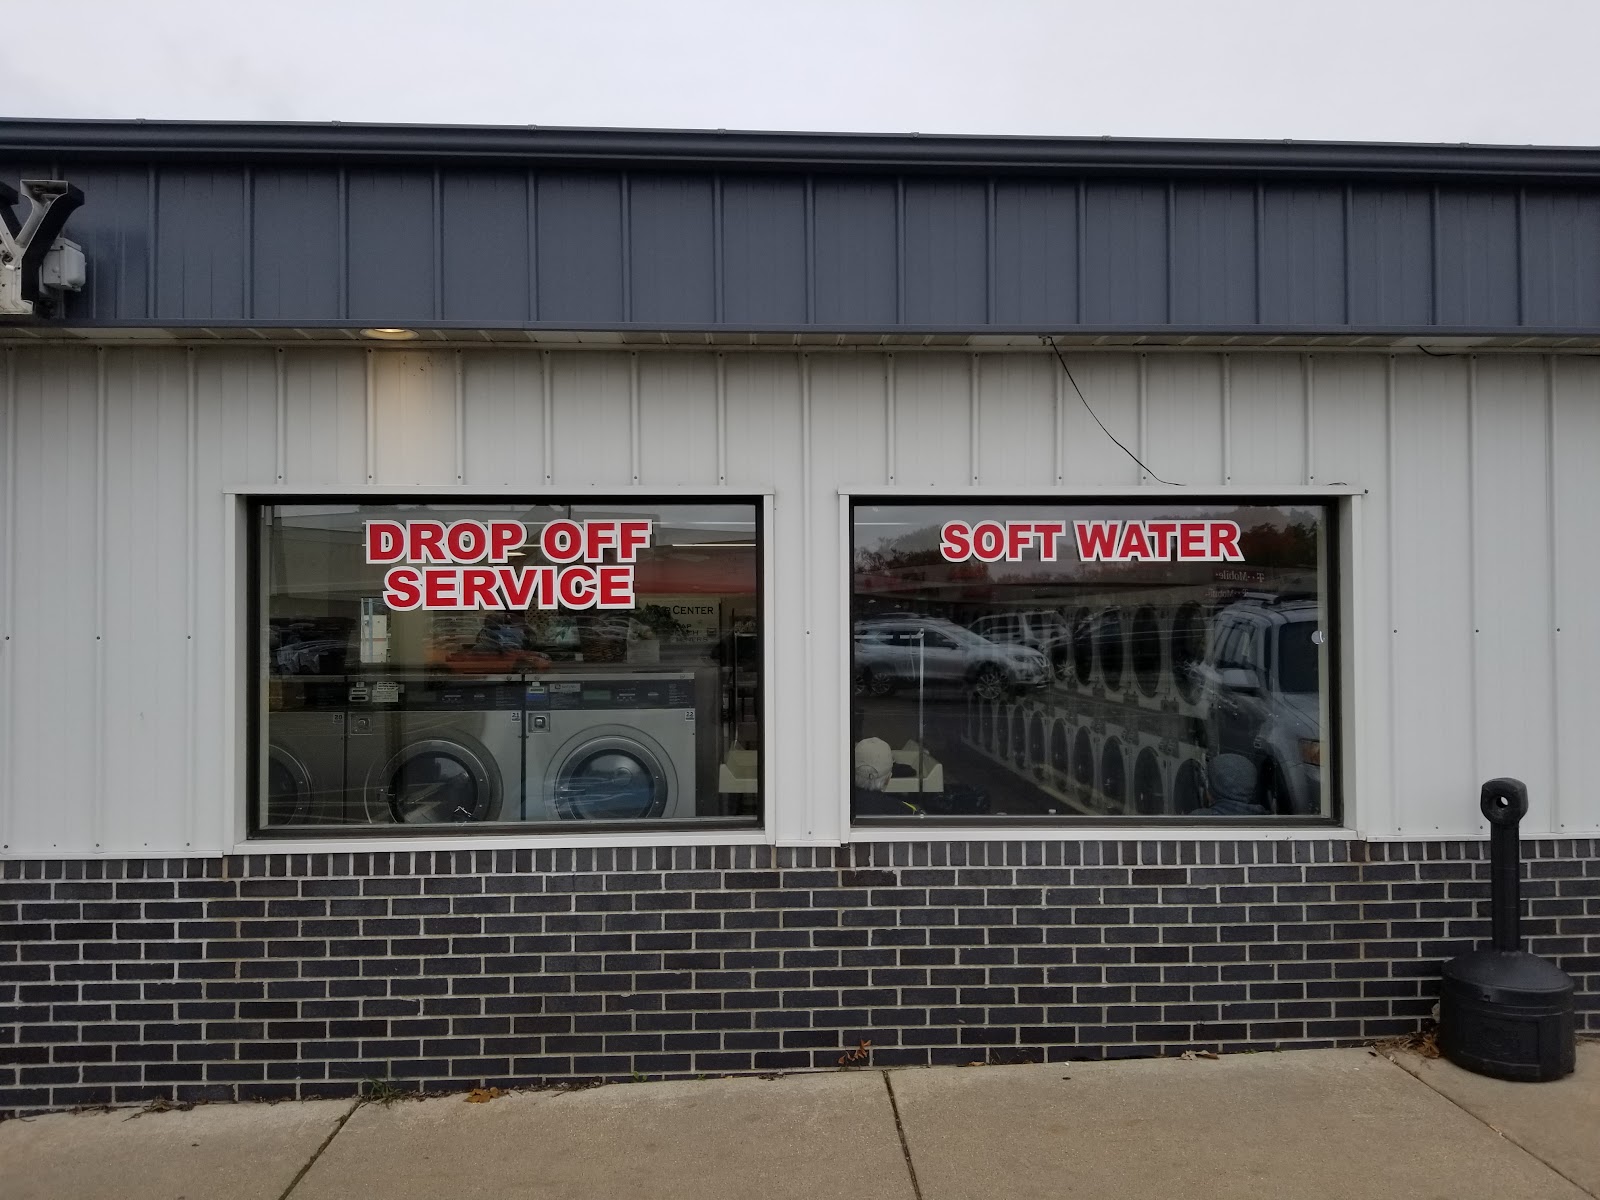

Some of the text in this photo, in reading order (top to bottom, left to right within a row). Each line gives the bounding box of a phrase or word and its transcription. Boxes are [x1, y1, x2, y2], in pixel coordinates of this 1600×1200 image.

[366, 519, 652, 564] DROP OFF
[940, 520, 1245, 562] SOFT WATER
[383, 565, 635, 611] SERVICE
[672, 605, 714, 615] CENTER
